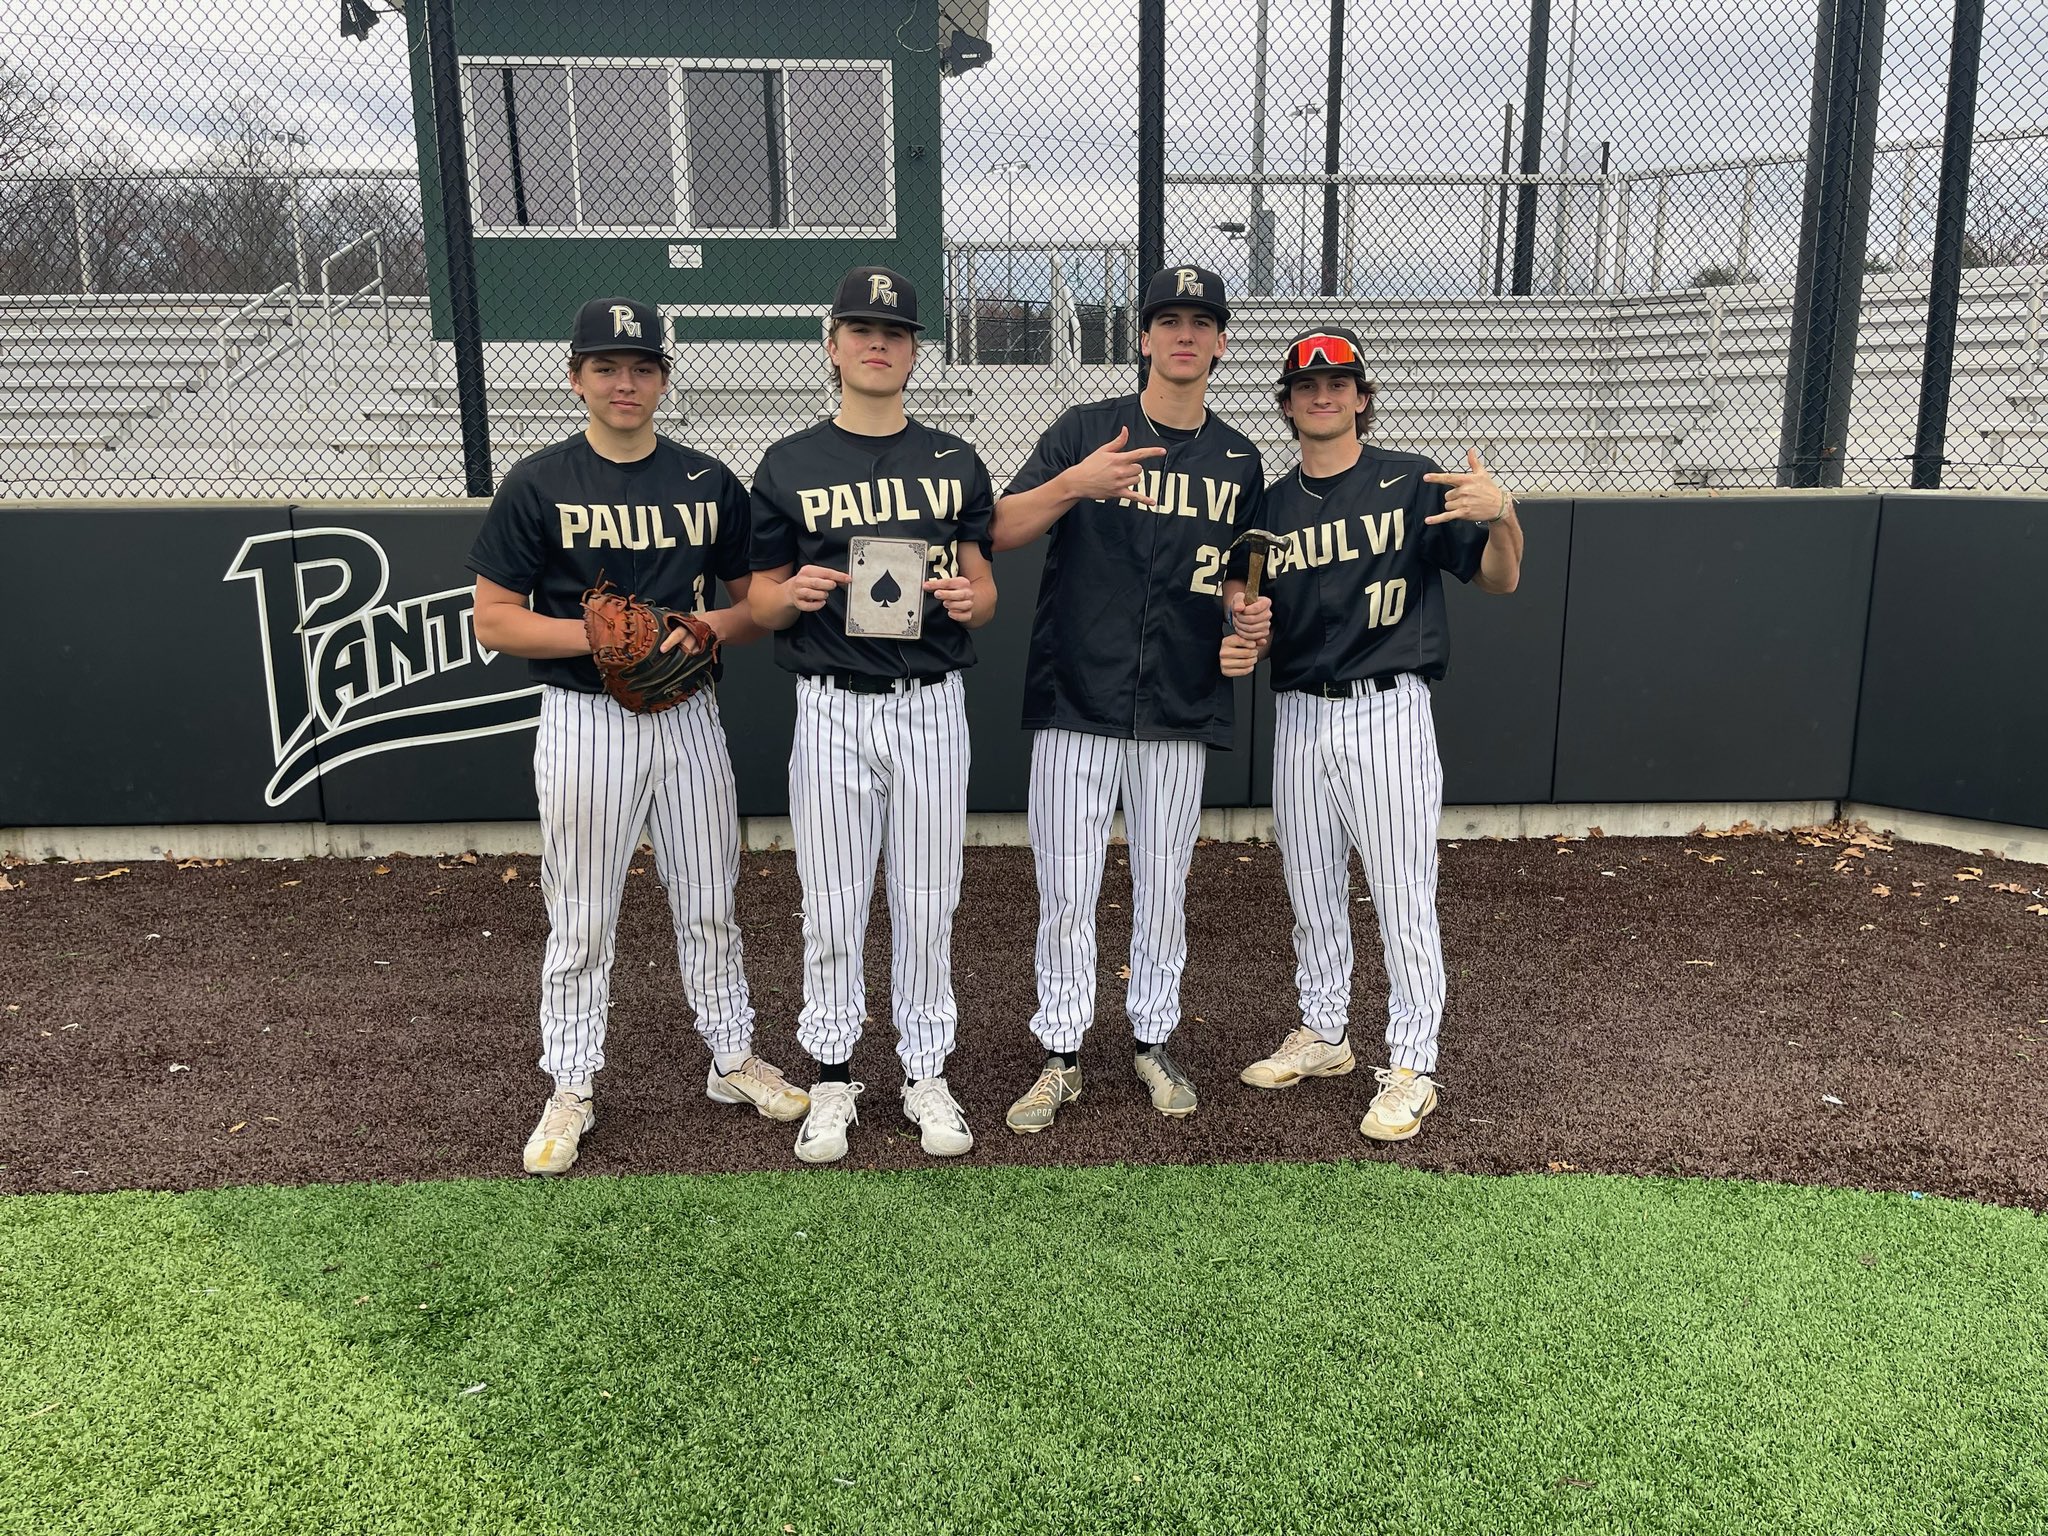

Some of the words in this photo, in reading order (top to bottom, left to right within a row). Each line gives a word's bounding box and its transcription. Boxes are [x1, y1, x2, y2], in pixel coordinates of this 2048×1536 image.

[796, 478, 921, 533] PAUL
[917, 478, 963, 521] VI
[1095, 469, 1198, 518] AUL
[1202, 477, 1241, 525] VI
[555, 503, 677, 550] PAUL
[673, 501, 718, 546] VI
[1360, 508, 1405, 556] VI
[1365, 577, 1407, 629] 10
[1025, 1108, 1053, 1117] VAPOR
